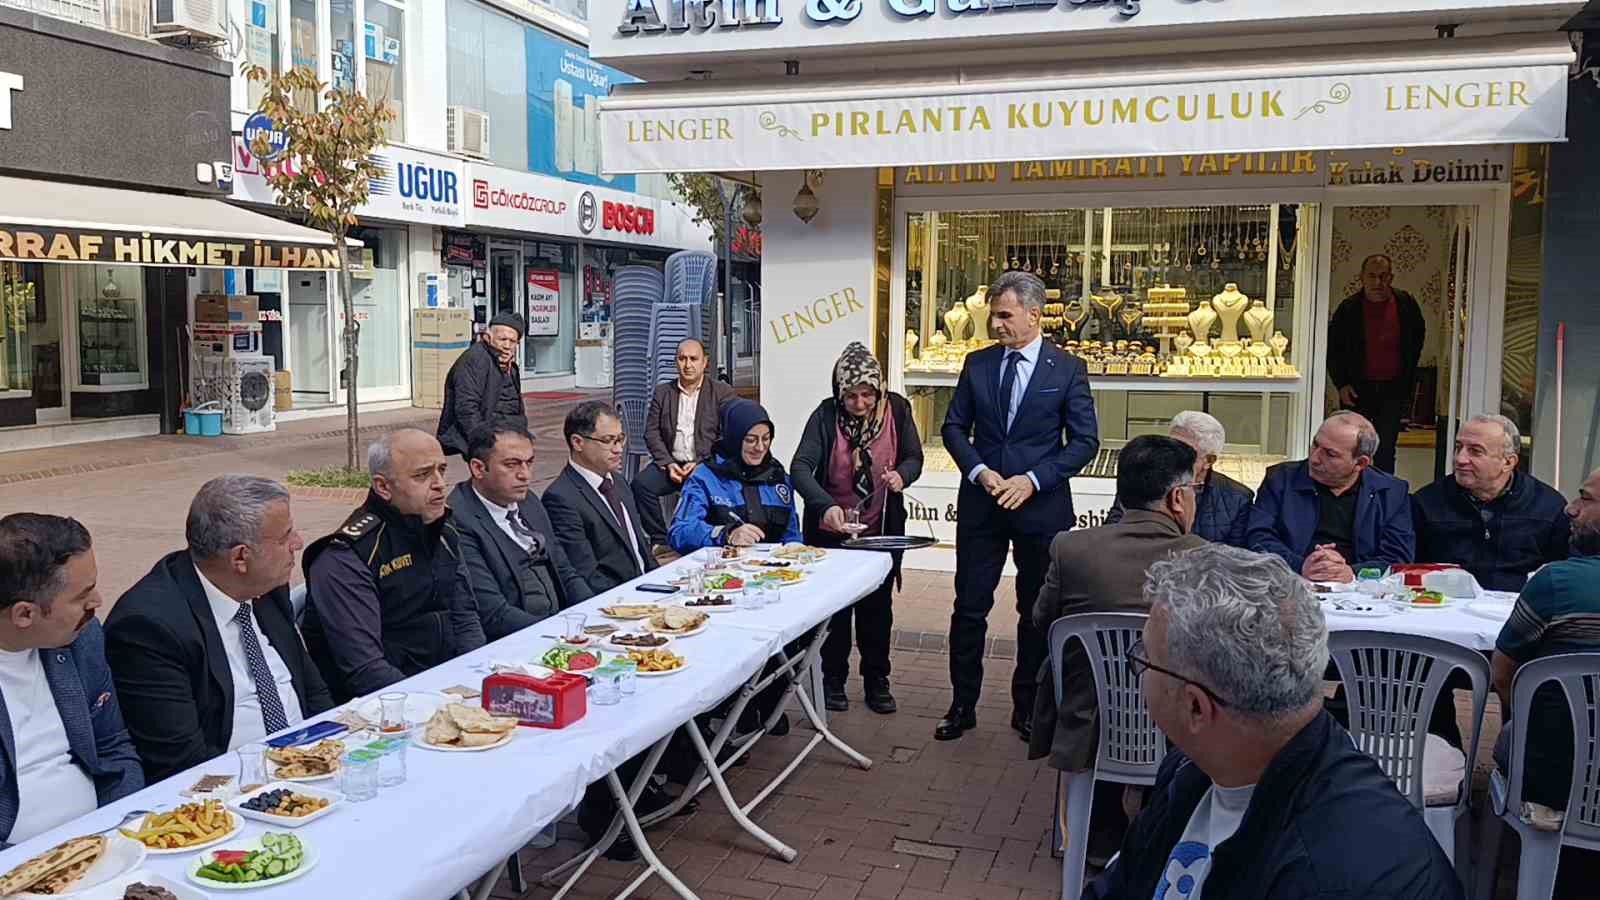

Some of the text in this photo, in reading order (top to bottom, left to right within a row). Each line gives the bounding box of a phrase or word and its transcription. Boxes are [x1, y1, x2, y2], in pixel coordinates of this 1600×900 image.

[626, 80, 1531, 144] LENGER PIRLANTA KUYUMCULUK LENGER
[398, 161, 458, 204] UĞUR
[1328, 158, 1504, 186] Kulak Delinir
[602, 200, 655, 235] BOSCH
[113, 231, 245, 265] HİKMET
[253, 239, 340, 268] İLHAN
[769, 286, 865, 345] LENGER
[908, 501, 939, 521] ltın
